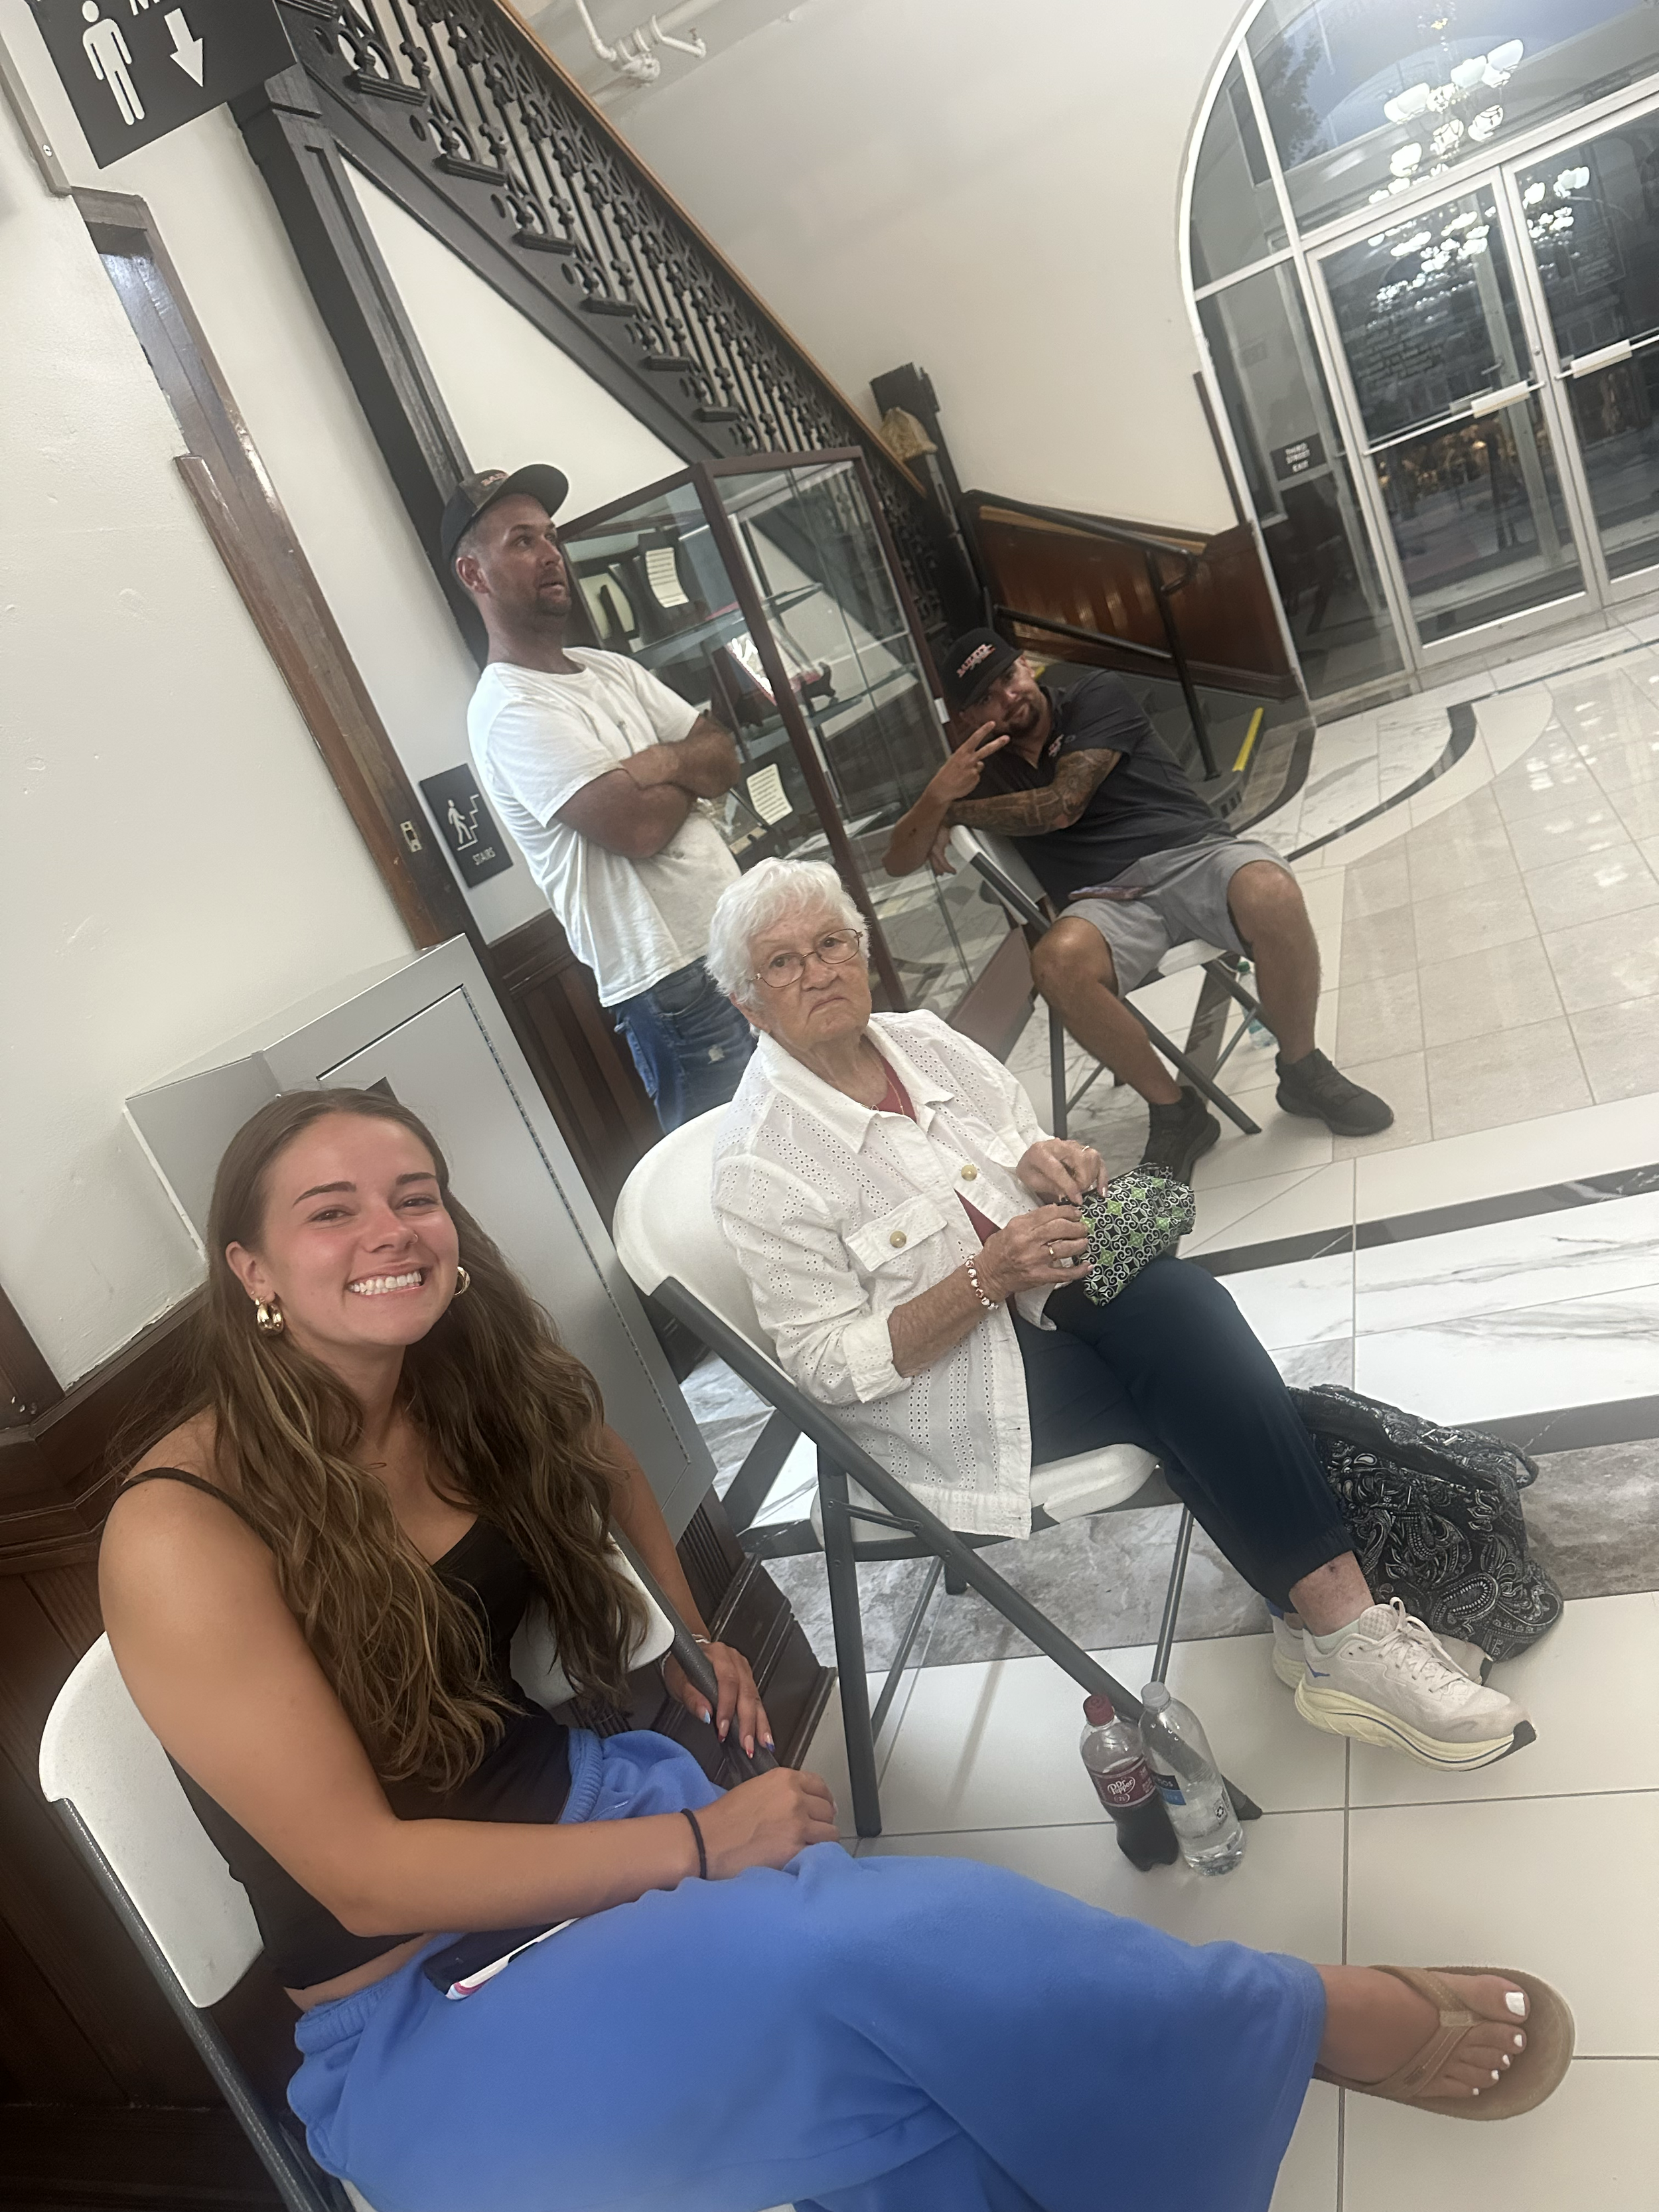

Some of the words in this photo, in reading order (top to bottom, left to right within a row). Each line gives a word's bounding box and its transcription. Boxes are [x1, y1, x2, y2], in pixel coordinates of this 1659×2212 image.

[472, 847, 496, 865] STAIRS
[1108, 1779, 1133, 1795] Pepper
[1116, 1779, 1126, 1788] Dr
